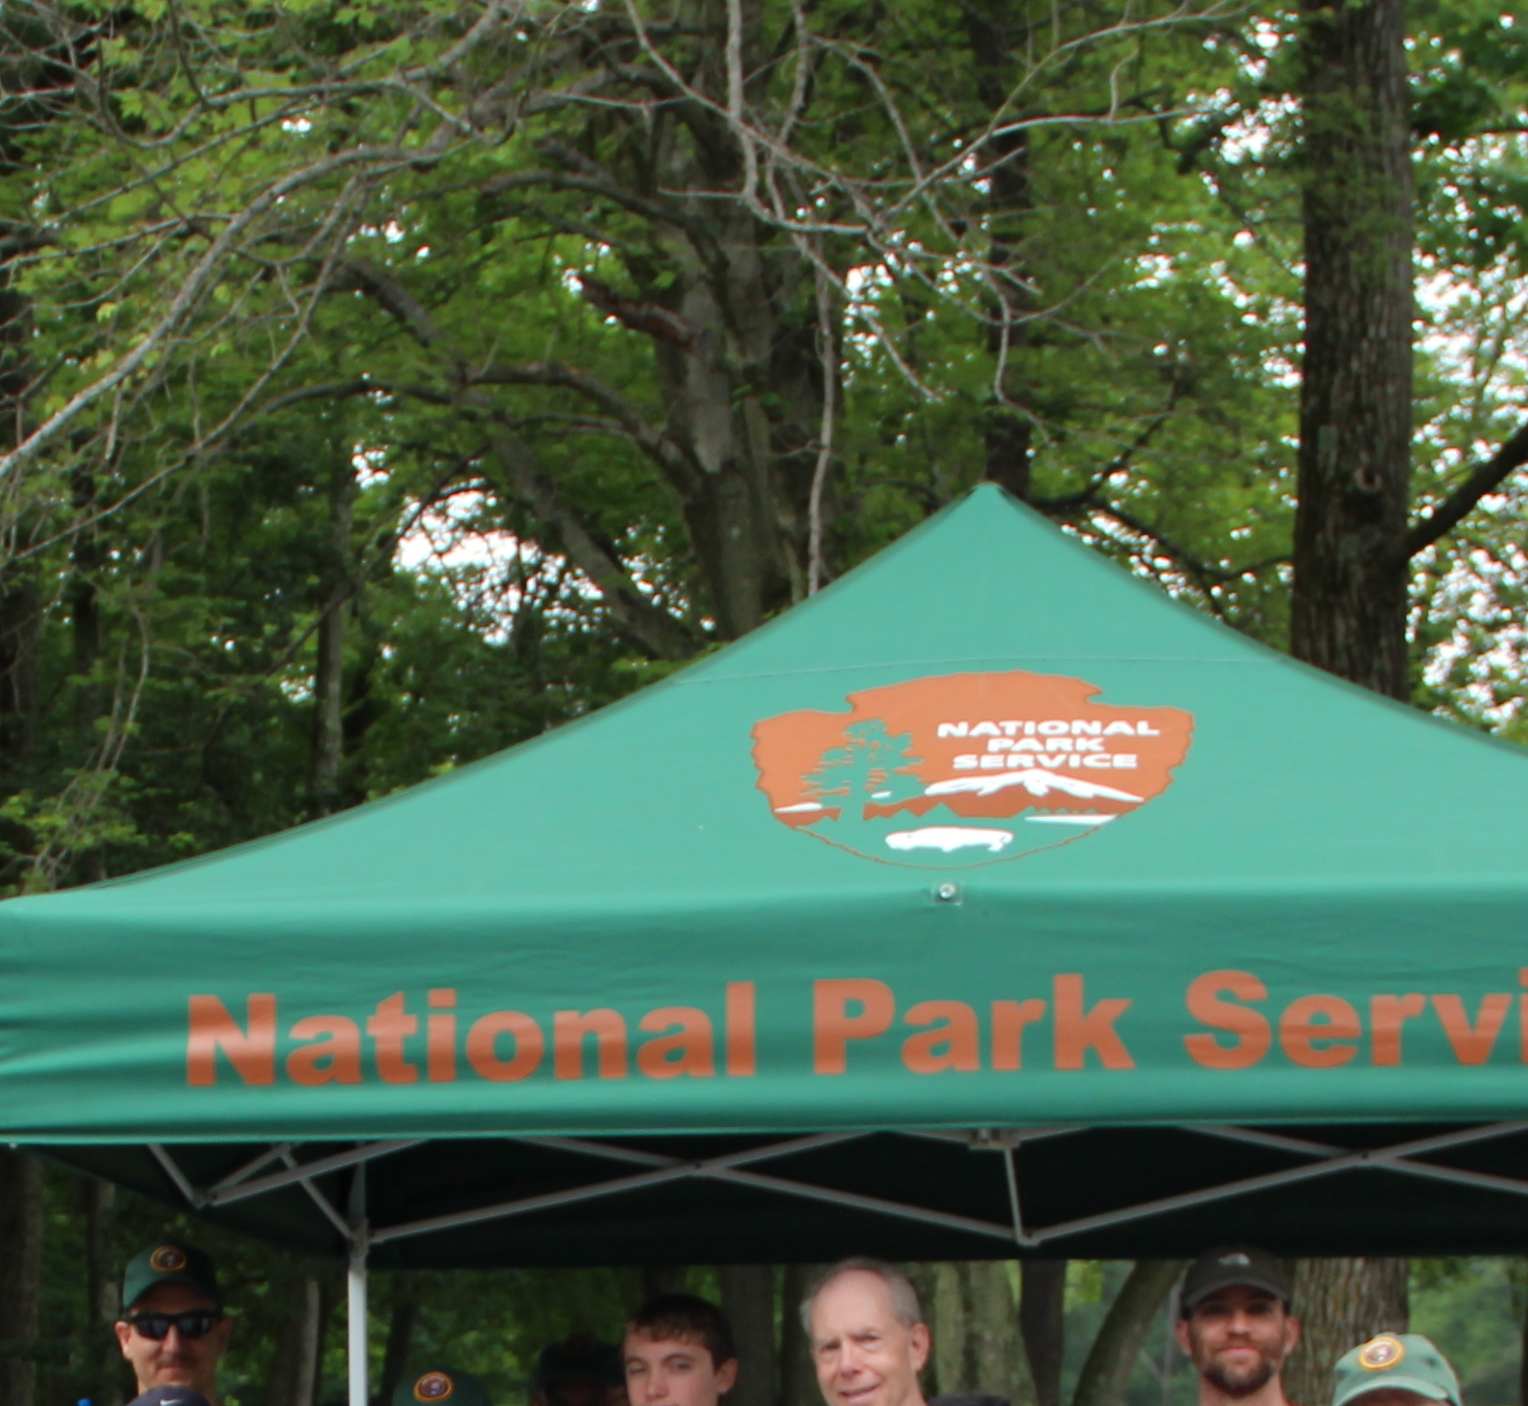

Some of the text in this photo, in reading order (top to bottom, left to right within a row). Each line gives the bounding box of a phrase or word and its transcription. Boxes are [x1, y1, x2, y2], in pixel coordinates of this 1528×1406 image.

[937, 720, 1161, 738] NATIONAL
[987, 737, 1105, 753] PARK
[952, 753, 1138, 770] SERVICE
[186, 981, 756, 1088] National
[812, 974, 1137, 1075] Park
